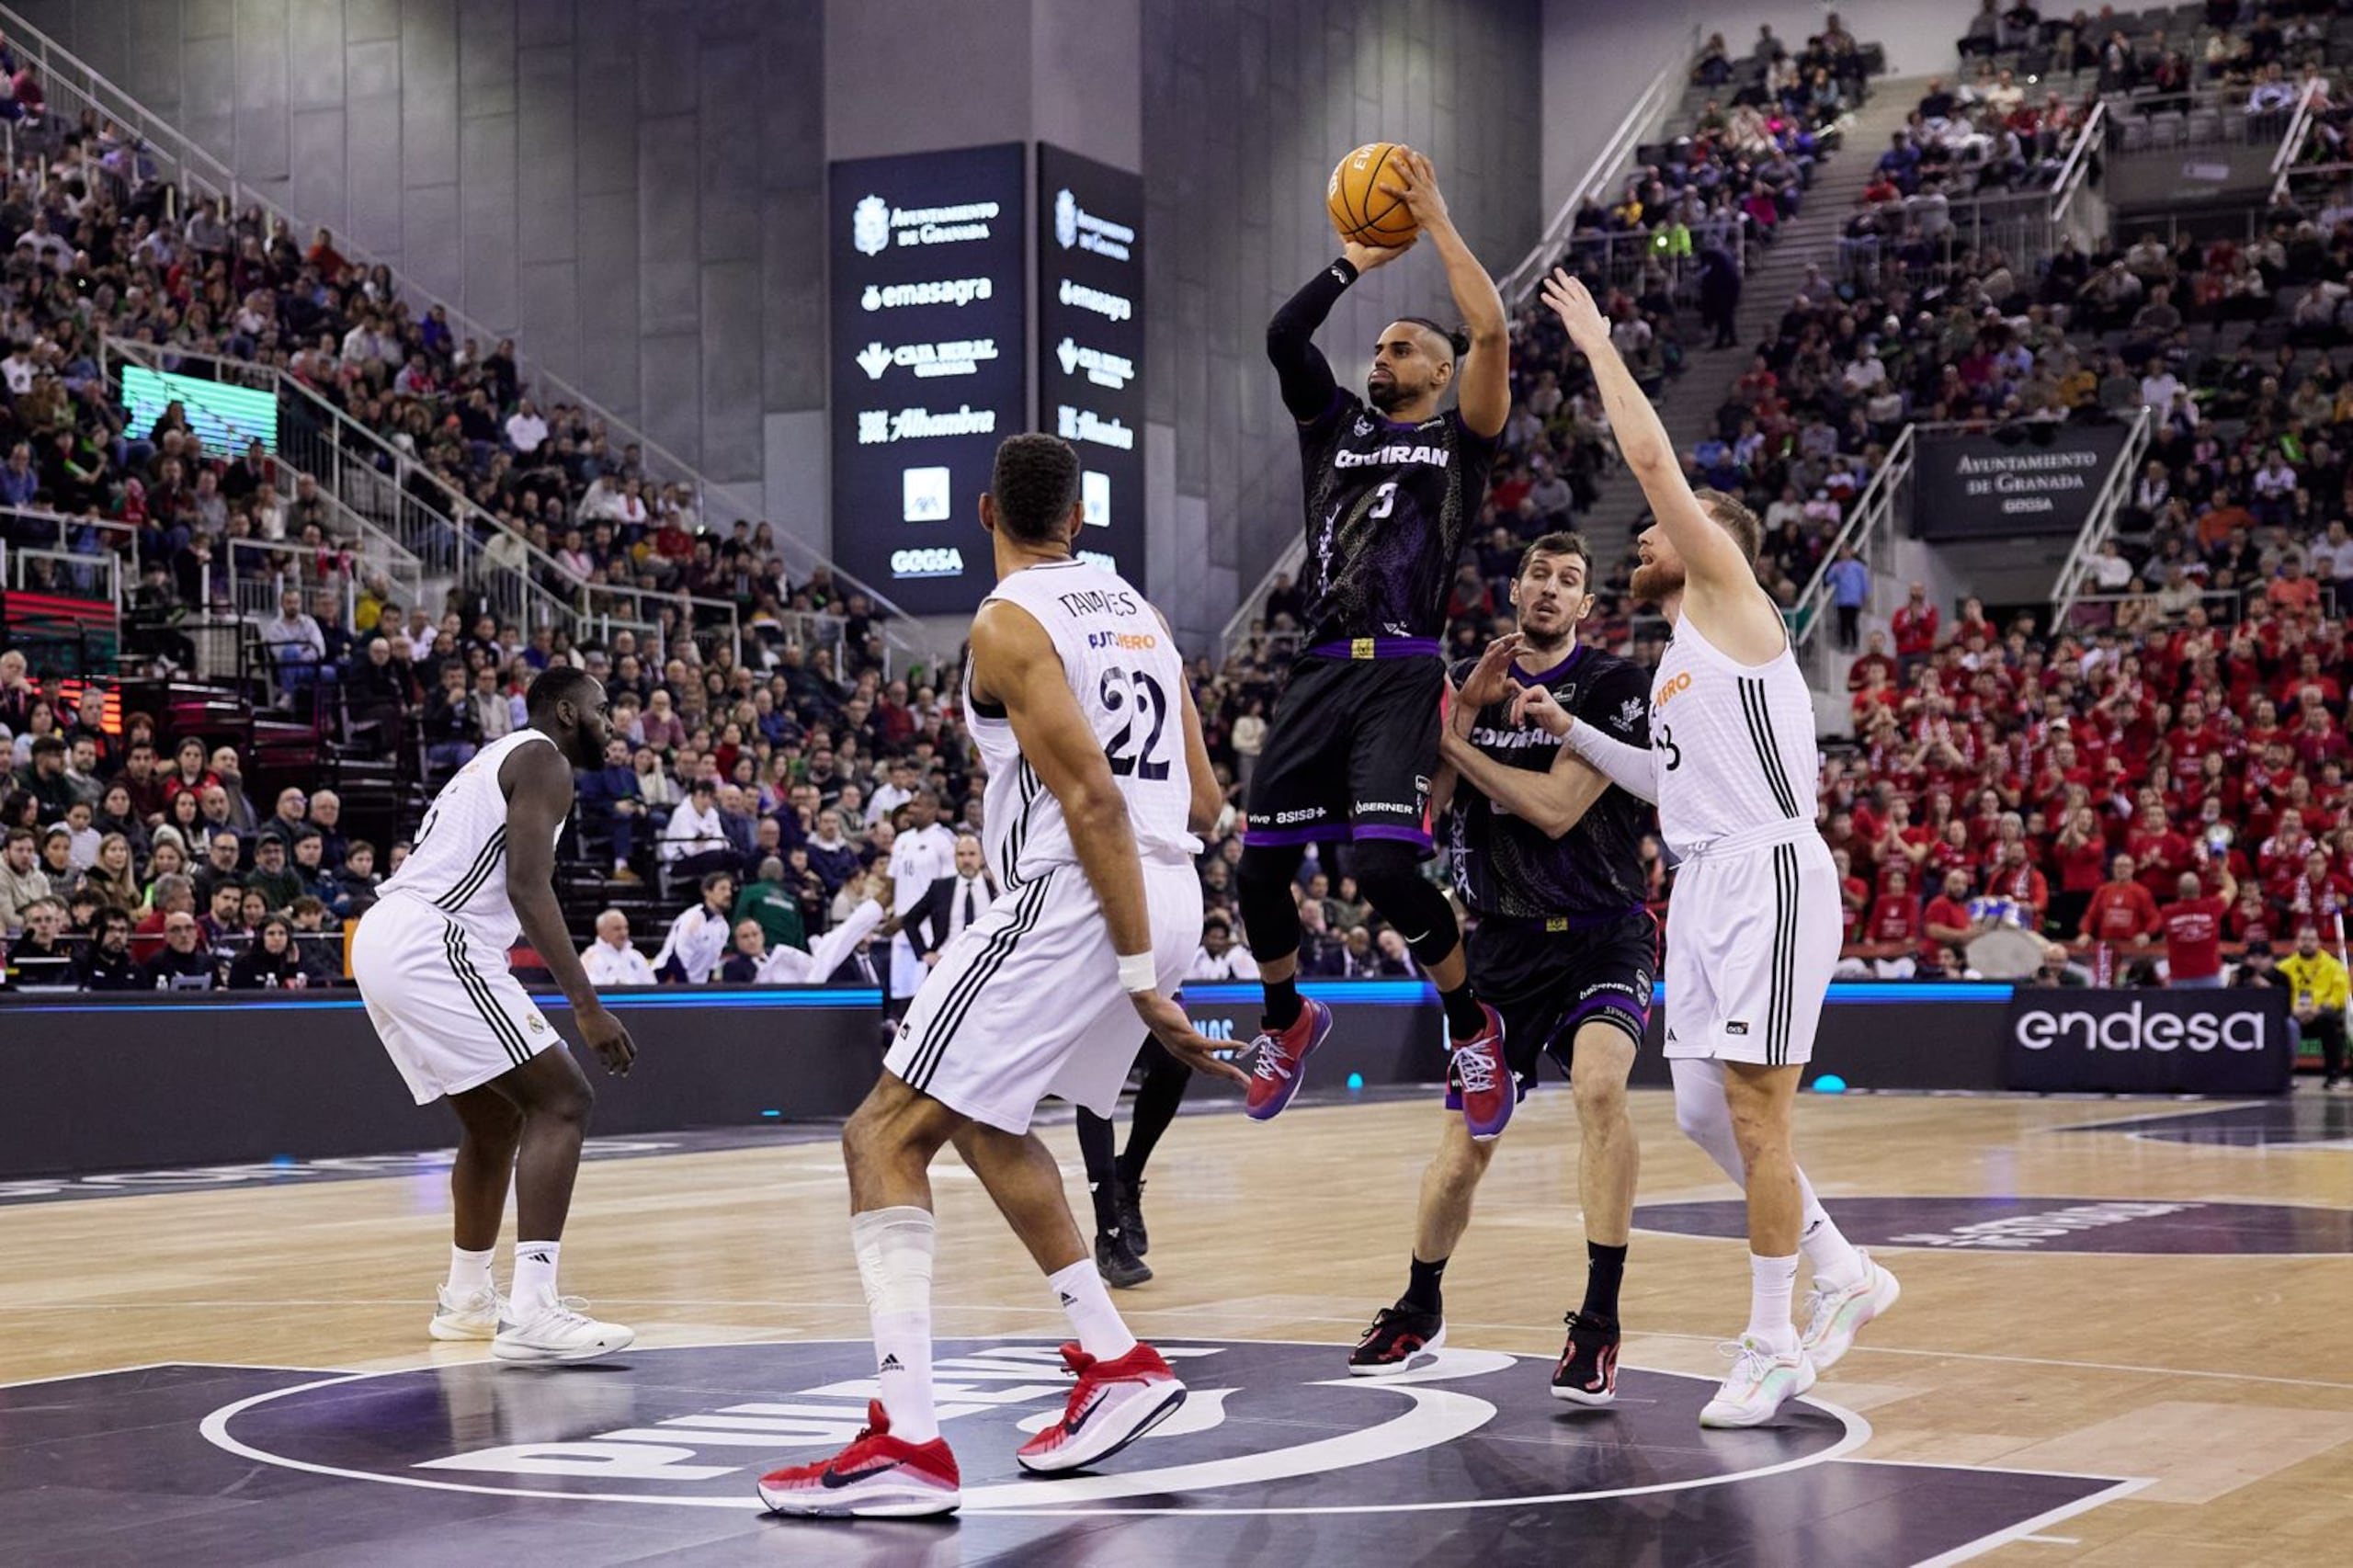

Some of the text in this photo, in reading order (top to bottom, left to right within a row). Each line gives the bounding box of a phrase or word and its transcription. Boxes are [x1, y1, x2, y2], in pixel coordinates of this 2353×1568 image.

[881, 277, 992, 307] emasagra
[1956, 450, 2097, 475] AYUNTAMIENTO
[1967, 472, 2085, 496] DE GRANADA
[1368, 482, 1399, 519] 3
[1099, 665, 1171, 782] 22
[1362, 802, 1414, 814] BERNER
[2016, 1000, 2265, 1051] endesa
